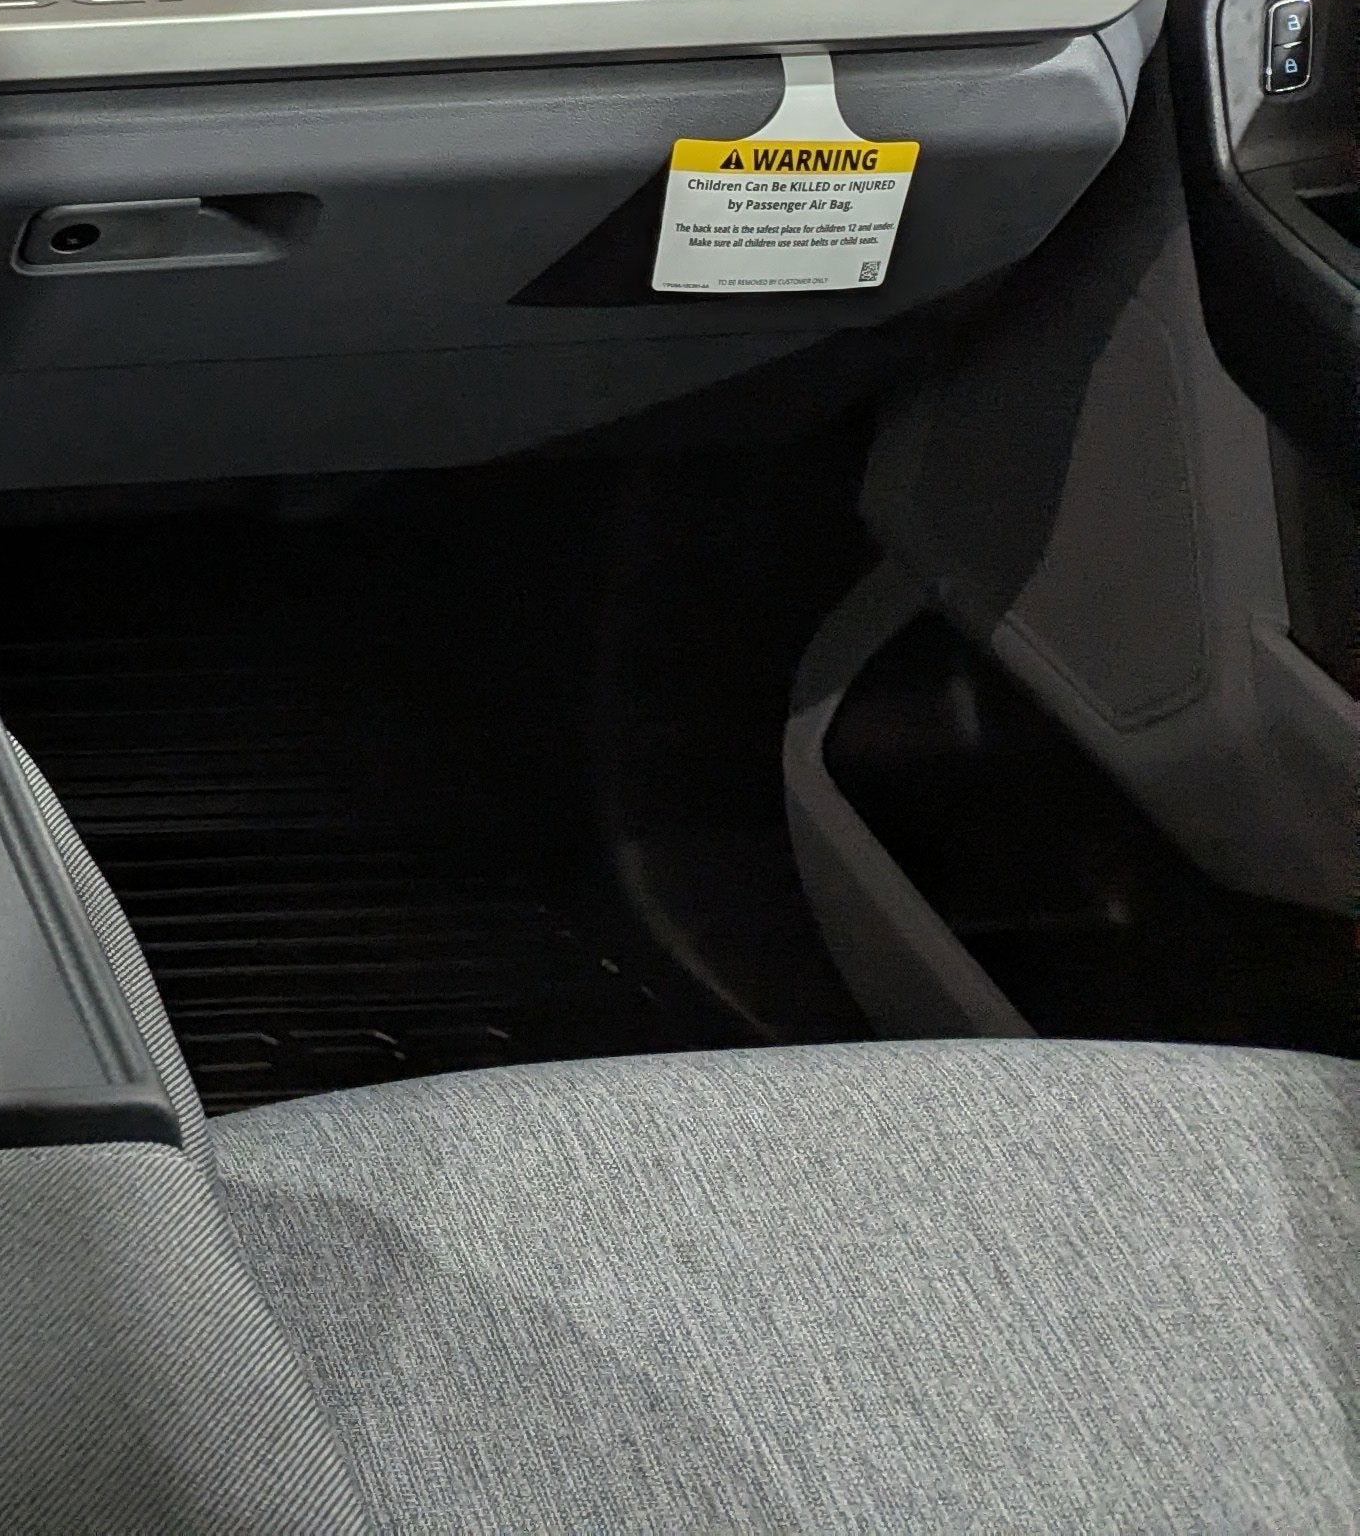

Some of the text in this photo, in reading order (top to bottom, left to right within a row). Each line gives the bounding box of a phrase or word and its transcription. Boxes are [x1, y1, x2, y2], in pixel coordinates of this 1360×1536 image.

[752, 148, 880, 172] WARNING
[687, 178, 896, 193] Children Can Be KILLED or INJURED
[727, 198, 854, 214] by Passenger Air Bag.
[675, 222, 691, 233] The
[693, 223, 712, 234] back
[713, 224, 731, 234] seat
[741, 224, 755, 234] the
[756, 224, 780, 234] safest
[780, 224, 801, 236] place
[802, 224, 815, 234] for
[815, 223, 846, 233] children
[857, 223, 872, 232] and
[688, 237, 713, 248] Make
[713, 239, 732, 248] sure
[732, 238, 743, 248] all
[744, 238, 776, 248] children
[778, 239, 792, 248] use
[793, 238, 809, 248] seat
[810, 237, 829, 247] belts
[830, 238, 839, 247] or
[840, 236, 858, 246] child
